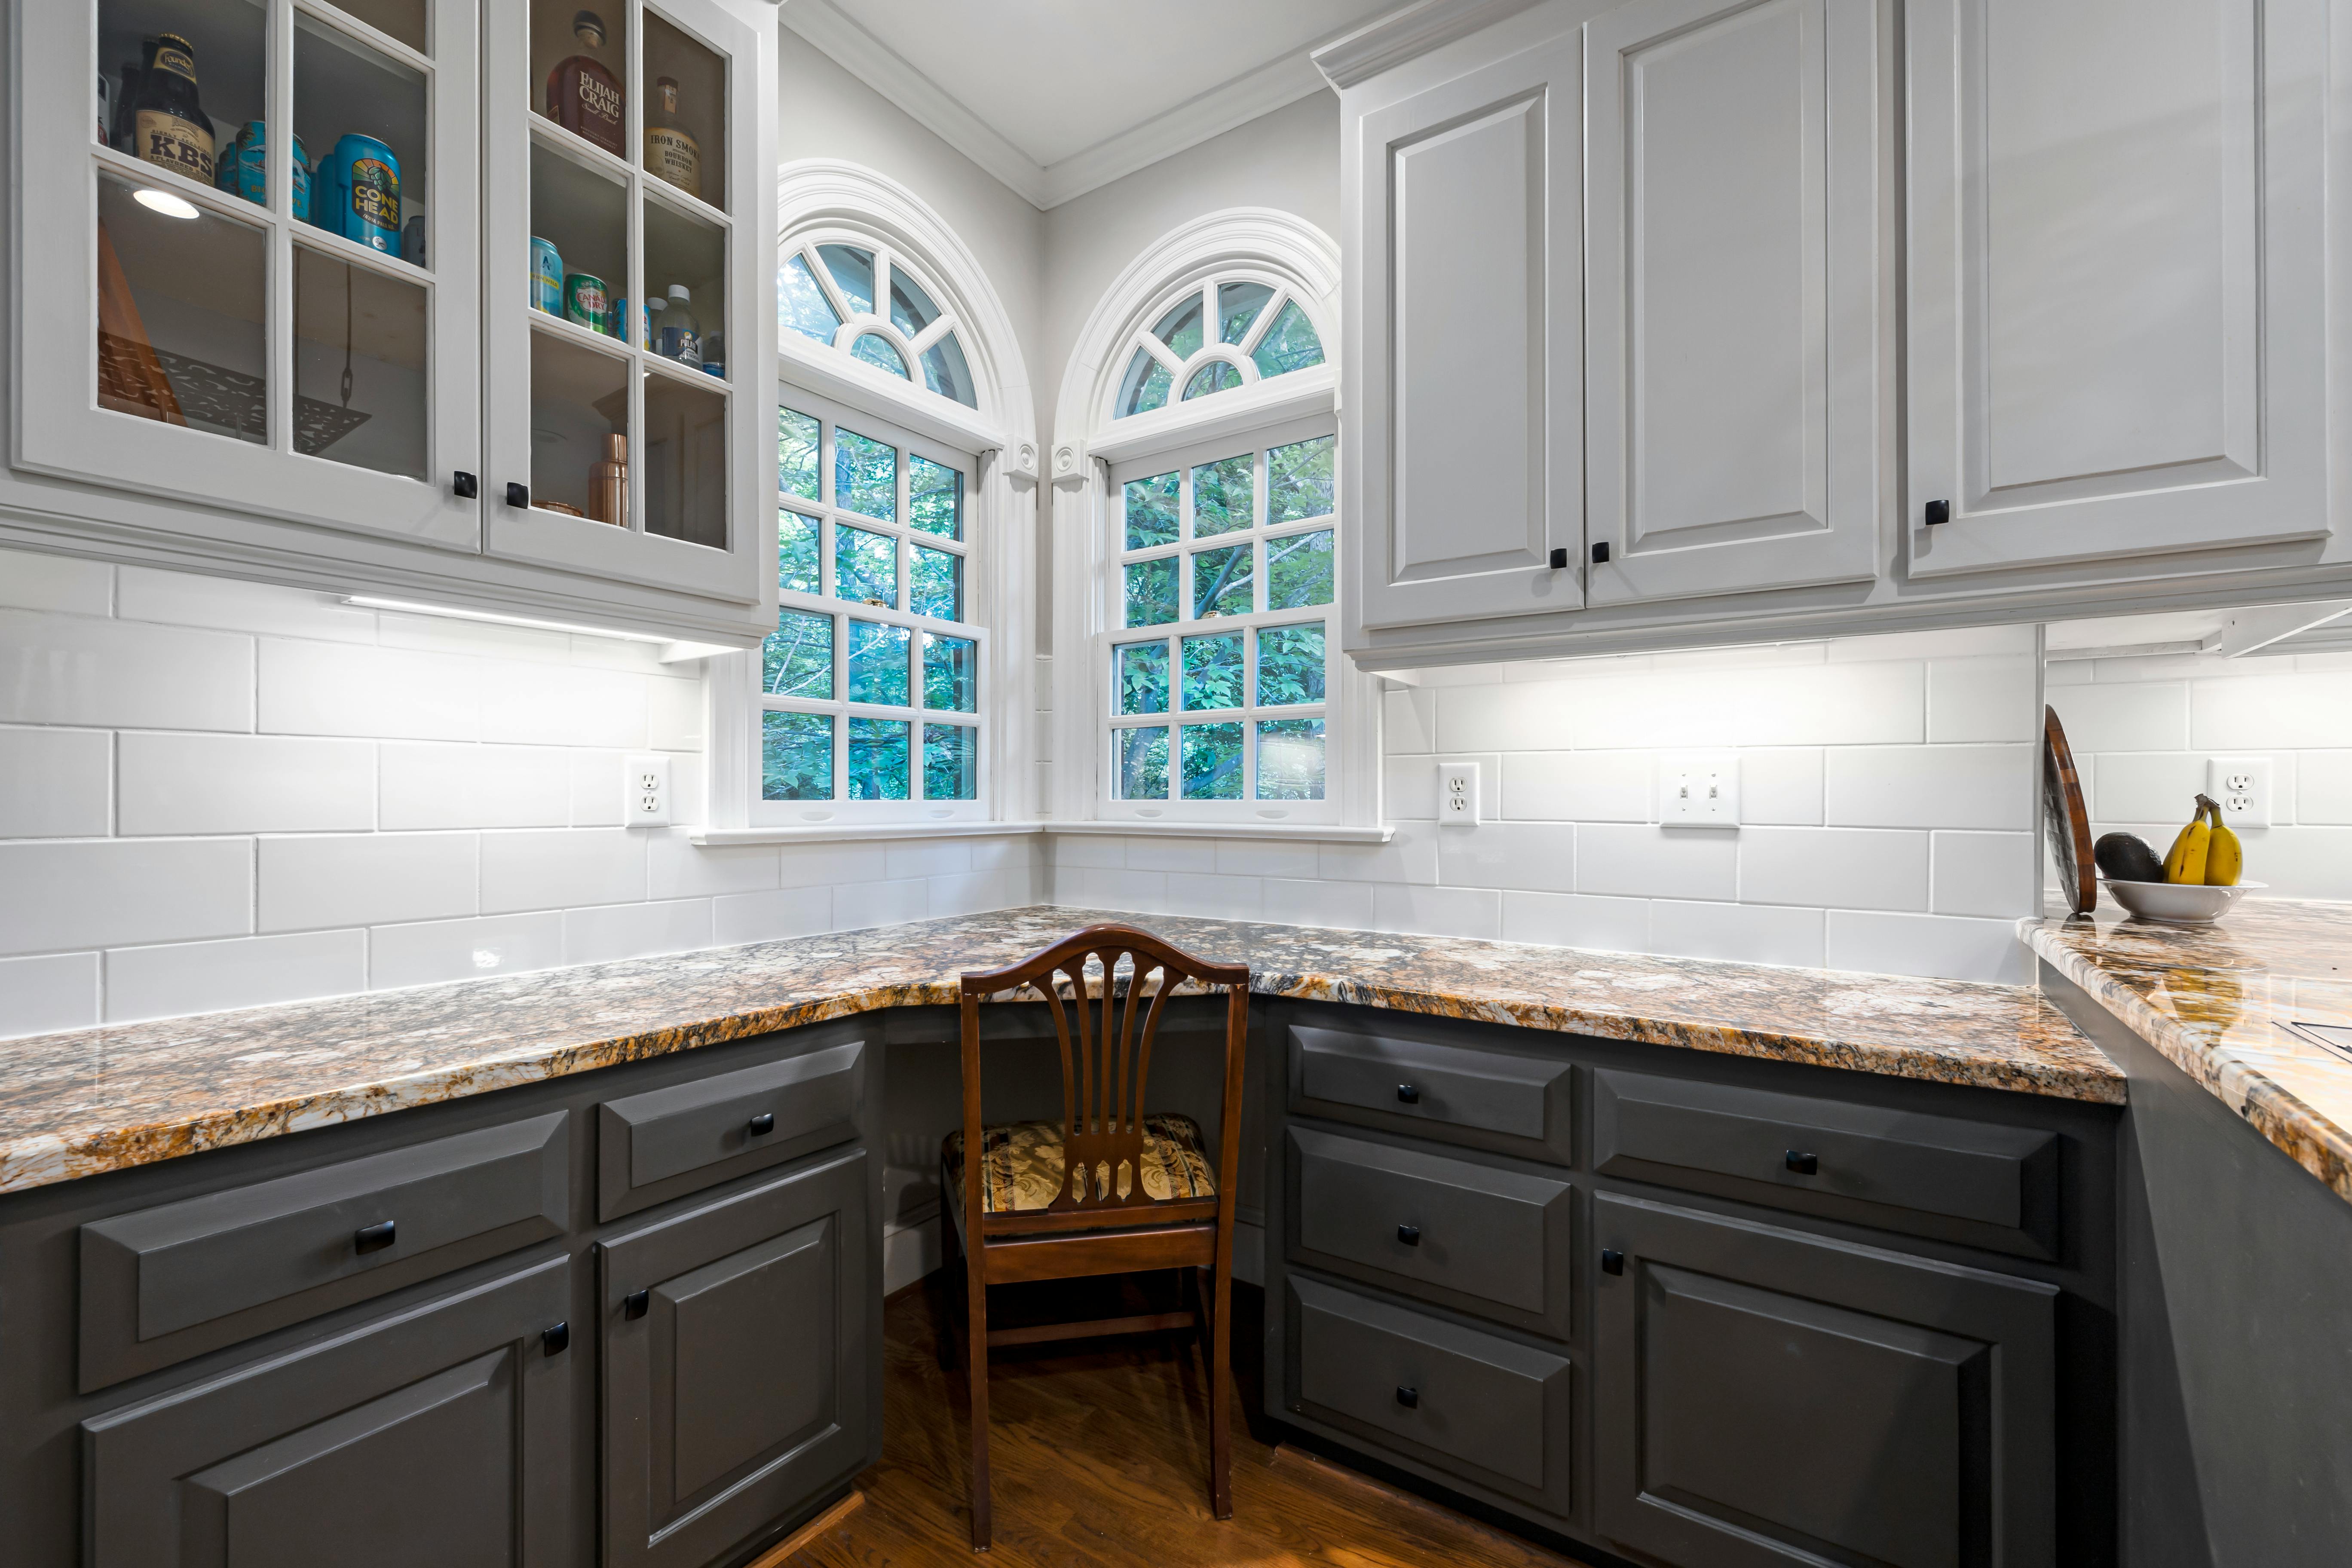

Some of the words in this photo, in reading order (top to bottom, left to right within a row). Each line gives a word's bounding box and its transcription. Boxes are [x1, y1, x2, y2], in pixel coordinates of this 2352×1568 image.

[579, 70, 619, 106] ELIJAH
[579, 85, 619, 118] CRAIG
[582, 103, 600, 115] Small
[599, 112, 618, 126] Batch
[650, 135, 674, 146] IRON
[150, 134, 212, 178] KBS
[665, 150, 692, 167] BOURBON
[665, 158, 692, 173] WHISKEY
[355, 186, 398, 214] CONE
[356, 198, 398, 224] HEAD
[363, 213, 377, 224] INDIA
[545, 278, 557, 287] WILD
[576, 292, 606, 303] CANAD
[588, 301, 605, 310] DRY
[680, 339, 696, 351] POLAR
